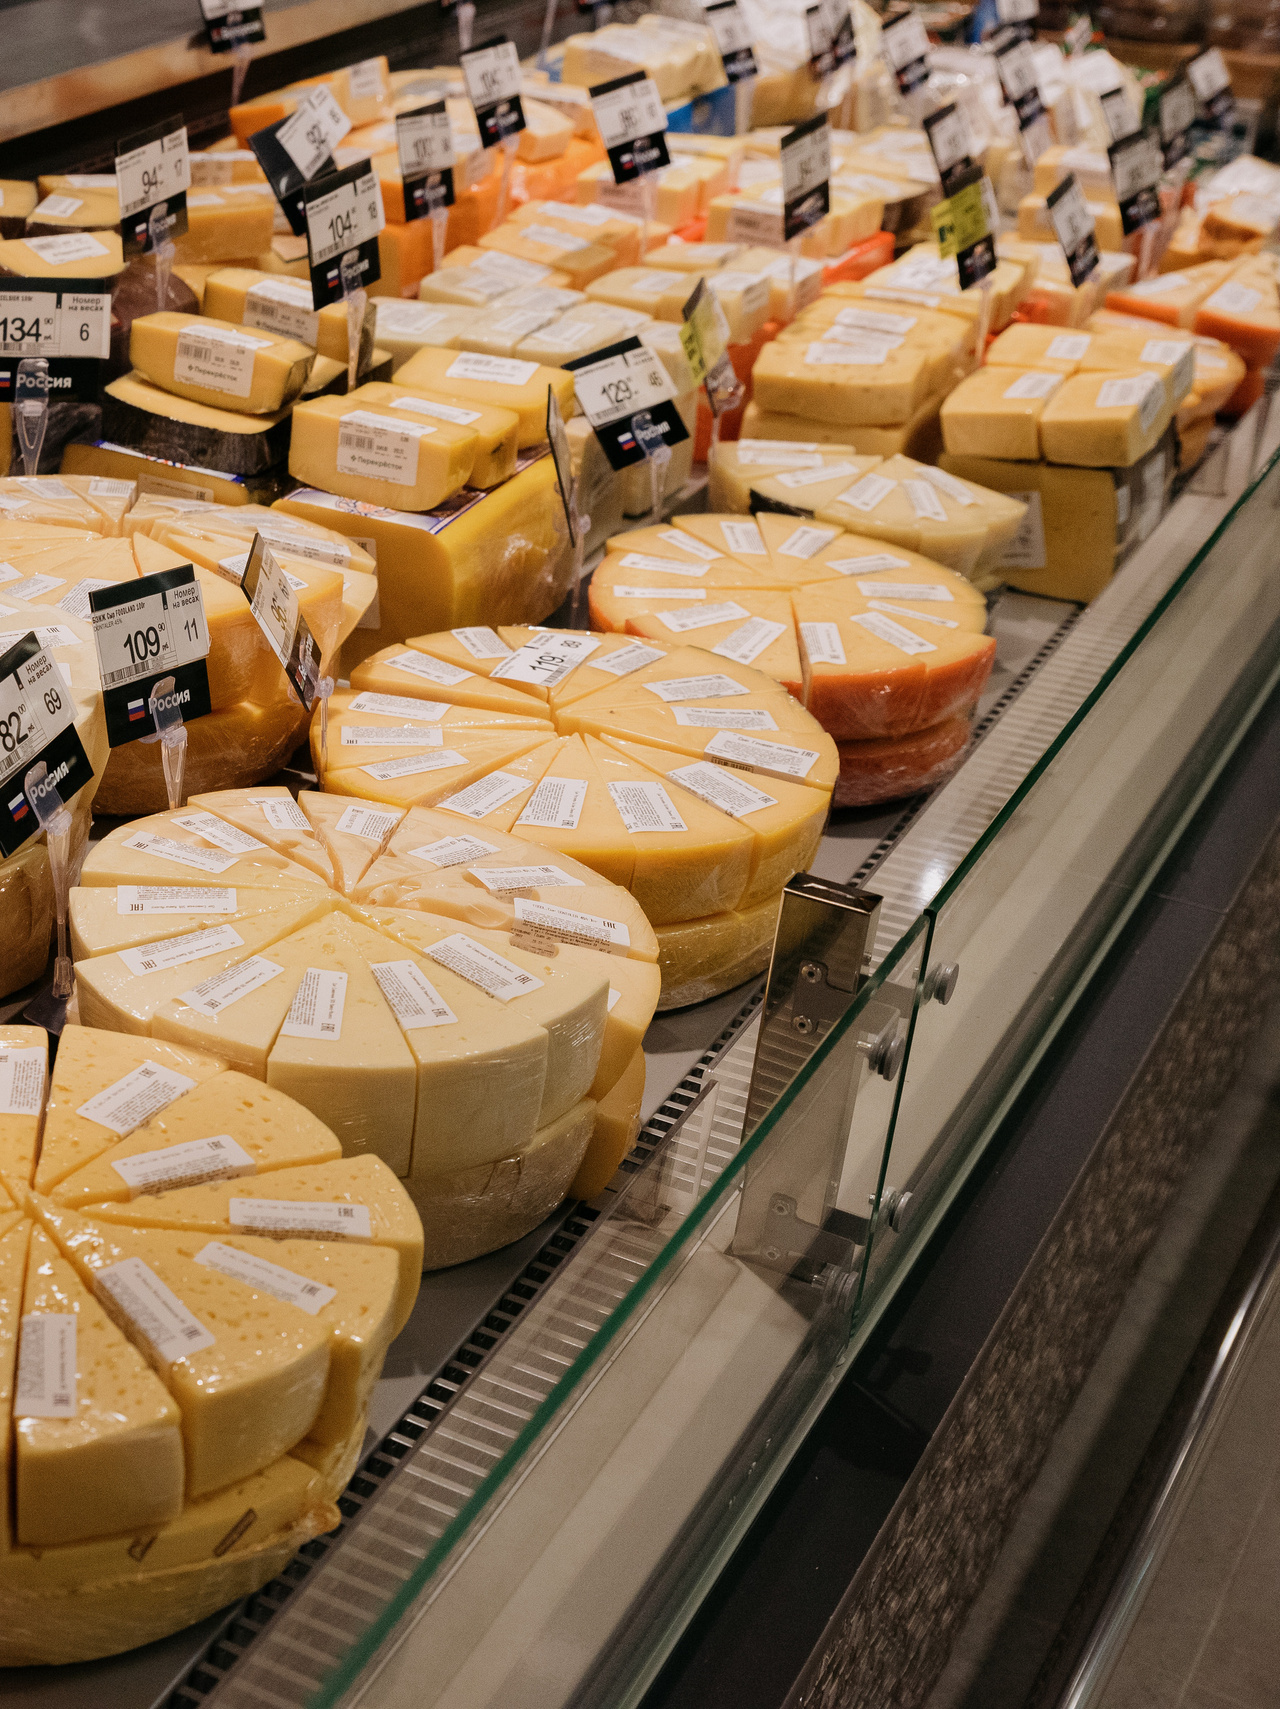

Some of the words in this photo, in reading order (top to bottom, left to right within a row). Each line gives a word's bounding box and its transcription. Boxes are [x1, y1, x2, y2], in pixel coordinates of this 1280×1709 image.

[142, 167, 158, 194] 94
[328, 209, 353, 242] 104
[72, 296, 101, 304] Номер
[80, 323, 90, 341] 6
[17, 374, 72, 388] Россия
[601, 380, 633, 404] 129
[174, 586, 195, 599] Номер
[180, 595, 199, 608] весах
[107, 612, 115, 620] Сыр
[115, 604, 135, 617] FOODLAND
[158, 622, 165, 632] 90
[184, 618, 199, 642] 11
[124, 626, 160, 664] 109
[26, 655, 47, 674] Номер
[529, 655, 564, 672] 119
[28, 676, 36, 685] на
[37, 664, 53, 680] весах
[19, 704, 26, 714] 00
[44, 687, 62, 714] 69
[148, 689, 190, 714] Россия
[30, 761, 69, 803] Россия
